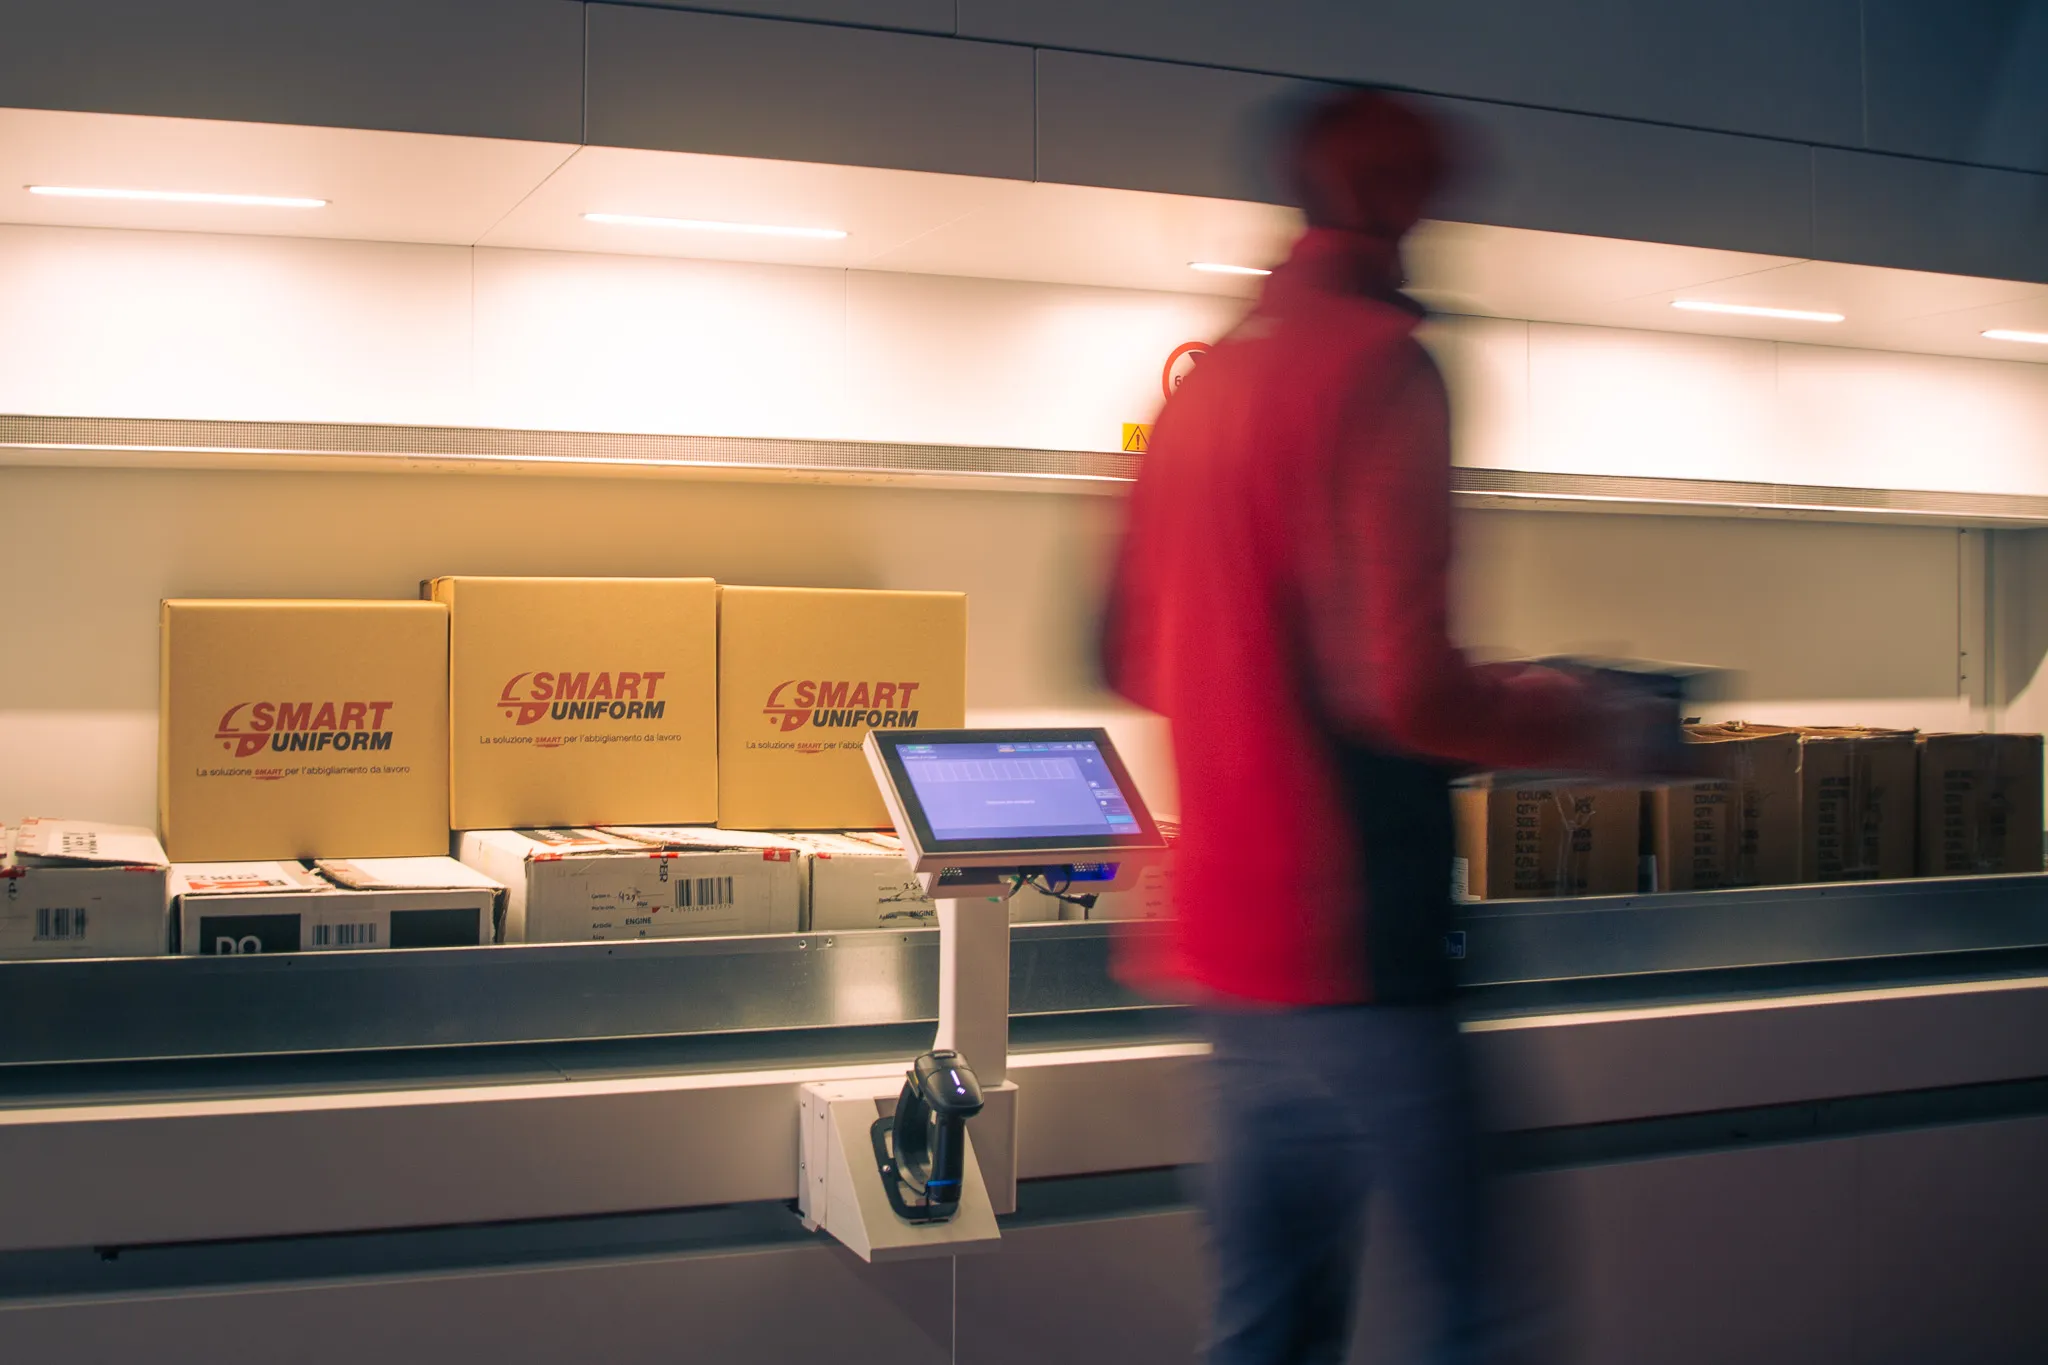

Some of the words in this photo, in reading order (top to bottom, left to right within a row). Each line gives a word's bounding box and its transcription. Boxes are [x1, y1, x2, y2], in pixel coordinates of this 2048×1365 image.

[531, 671, 666, 701] SMART
[794, 680, 920, 709] SMART
[250, 701, 394, 732] SMART
[551, 700, 666, 721] UNIFORM
[813, 709, 920, 728] UNIFORM
[272, 731, 394, 752] UNIFORM
[480, 735, 491, 744] La
[493, 734, 533, 744] soluzione
[564, 735, 578, 745] per
[580, 733, 642, 744] l'abbigliamento
[644, 733, 655, 742] da
[657, 733, 682, 742] lavoro
[746, 741, 756, 749] La
[758, 741, 795, 749] soluzione
[824, 743, 836, 751] per
[196, 768, 208, 777] La
[210, 768, 252, 776] soluzione
[254, 768, 283, 776] SMART
[285, 767, 299, 777] per
[302, 766, 368, 776] l'abbigliamento
[370, 766, 382, 774] da
[384, 765, 411, 774] lavoro
[625, 917, 652, 926] ENGINE
